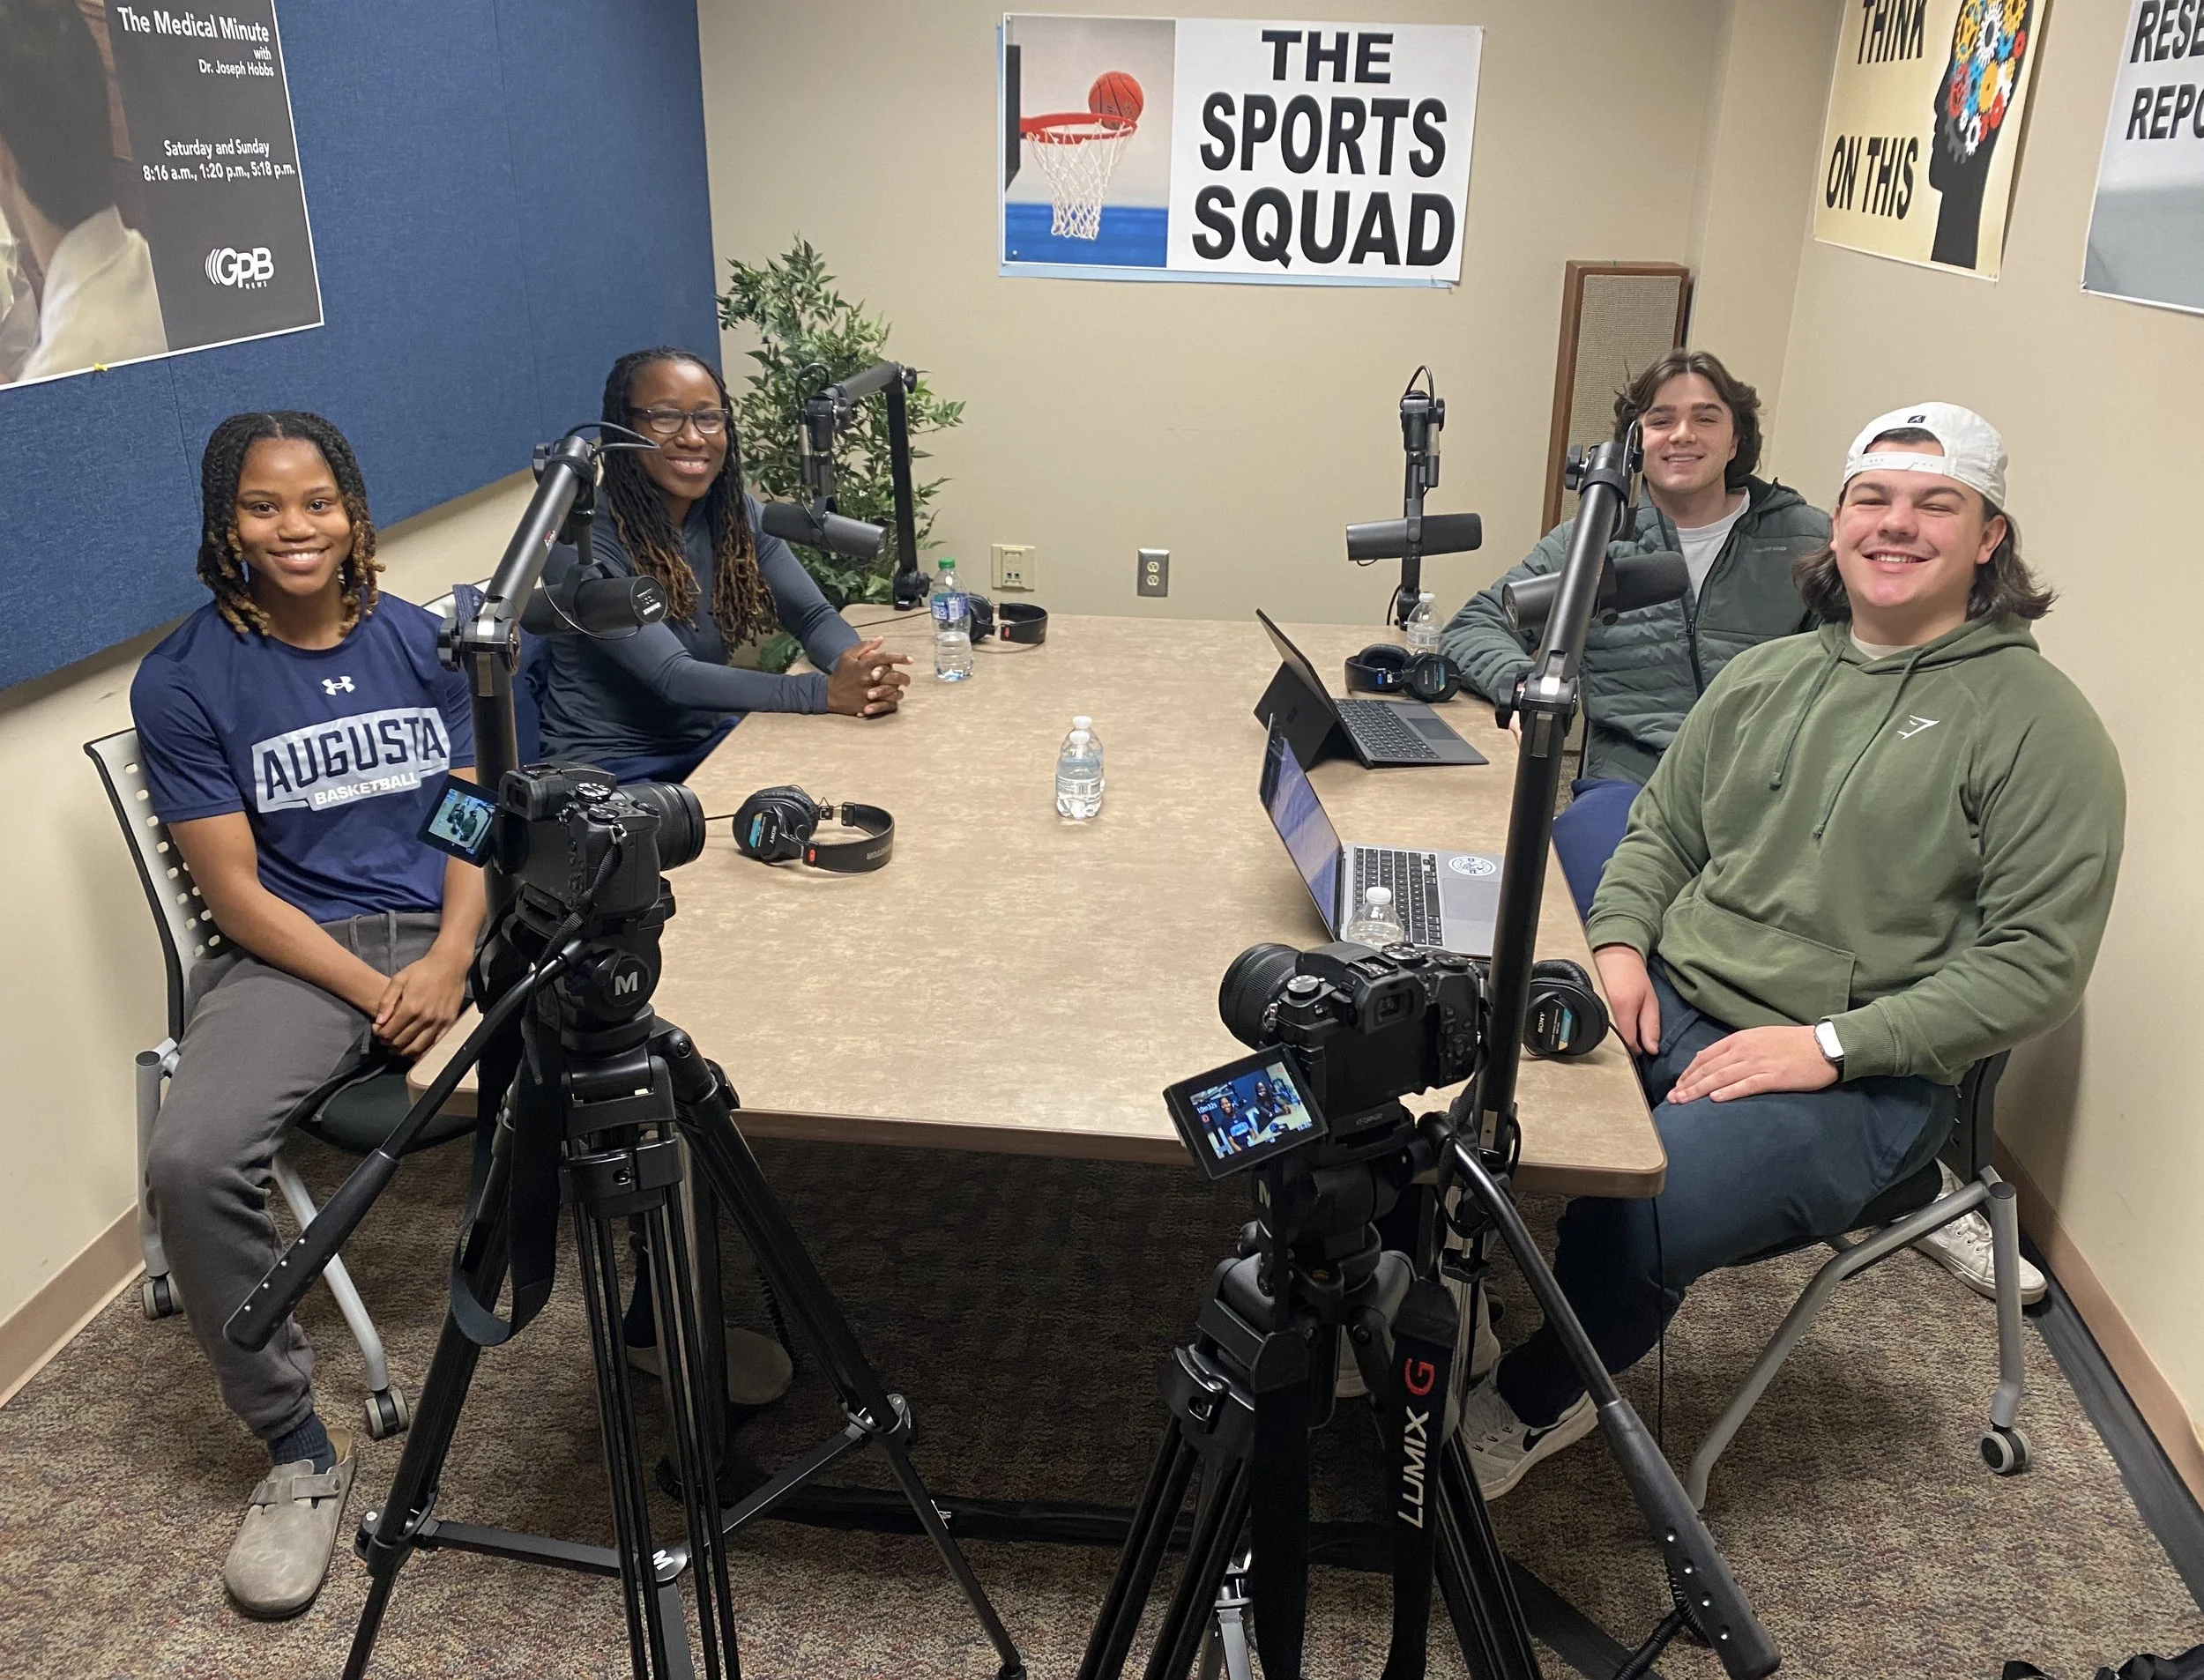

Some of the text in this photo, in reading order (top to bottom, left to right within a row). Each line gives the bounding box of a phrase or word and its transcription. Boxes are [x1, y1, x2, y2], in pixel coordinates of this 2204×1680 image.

[116, 6, 270, 42] The Medical Minute
[1858, 0, 1927, 64] THINK
[198, 58, 274, 79] Dr. Joseph Hobbs
[253, 46, 272, 60] with
[1261, 29, 1394, 84] THE
[163, 138, 270, 160] Saturday and Sunday
[1200, 91, 1448, 178] SPORTS
[142, 160, 295, 182] 8:16 a.m., 1:20 p.m., 5:18 p.m.
[1826, 134, 1919, 219] ON THIS
[1192, 184, 1456, 269] SQUAD
[216, 247, 274, 288] GPB
[263, 717, 447, 801] AUGUSTA
[315, 772, 418, 806] BASKETBALL
[614, 971, 638, 996] M
[1397, 1358, 1435, 1528] LUMIX G
